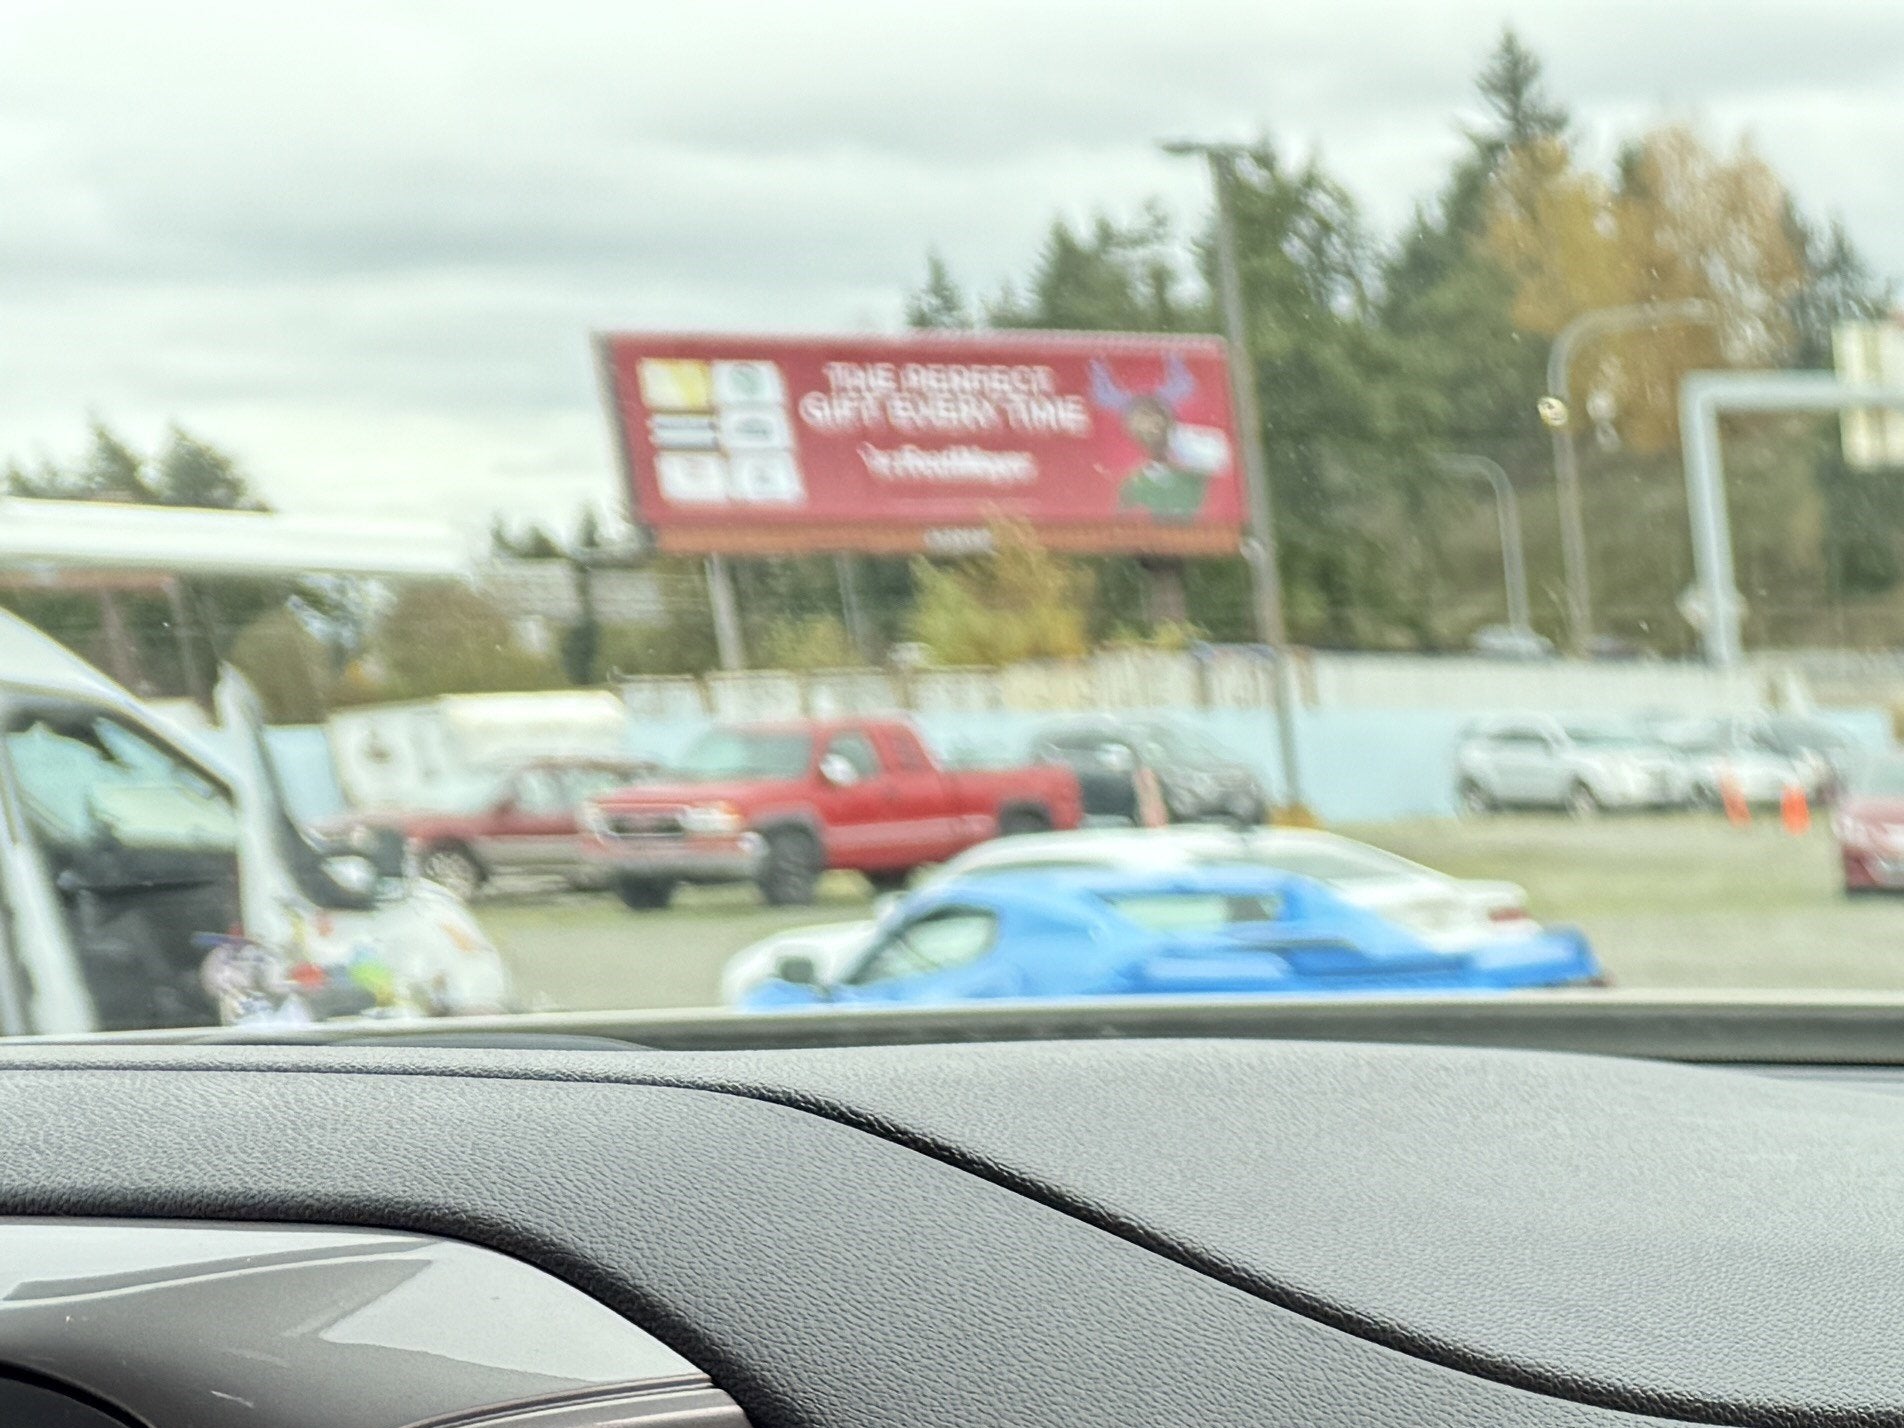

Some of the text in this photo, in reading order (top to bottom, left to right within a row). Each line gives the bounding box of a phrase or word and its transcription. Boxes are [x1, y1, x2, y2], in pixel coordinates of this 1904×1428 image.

[822, 362, 1055, 396] THE PERFECT
[799, 391, 1091, 437] GIFT EVERY TIME
